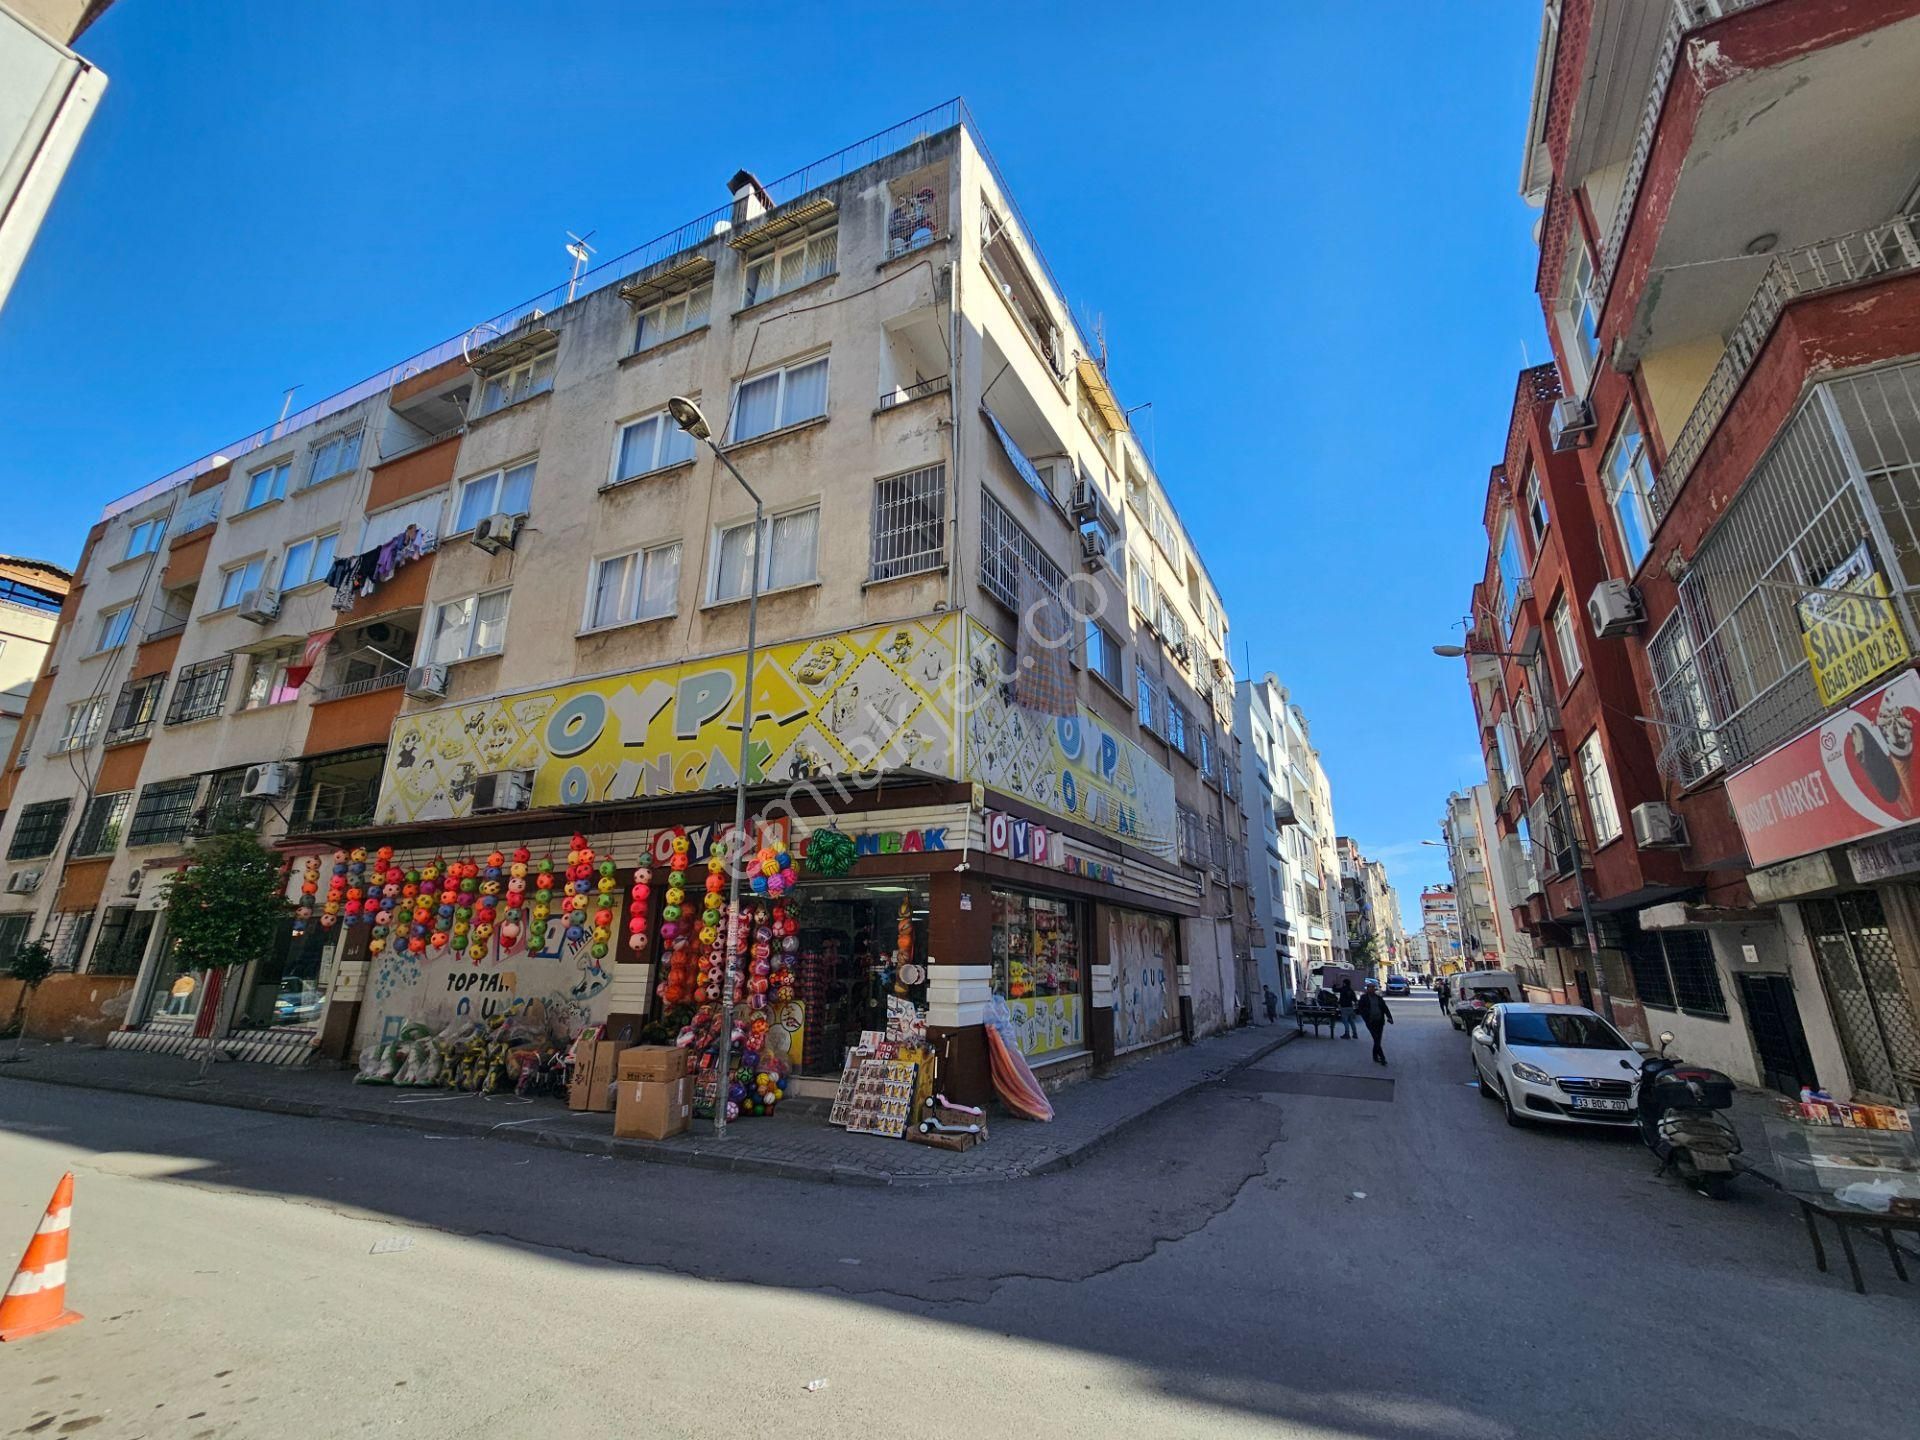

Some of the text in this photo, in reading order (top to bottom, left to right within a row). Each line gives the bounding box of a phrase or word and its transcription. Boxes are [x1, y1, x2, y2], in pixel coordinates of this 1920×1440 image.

[1810, 580, 1890, 671] SATILIK
[1821, 627, 1902, 699] 0546 580 82 83
[544, 653, 815, 758] OYPA
[561, 739, 773, 804] OYUNCAK
[1775, 770, 1829, 819] MARKET
[1579, 1098, 1588, 1107] 33
[1611, 1101, 1626, 1110] 207
